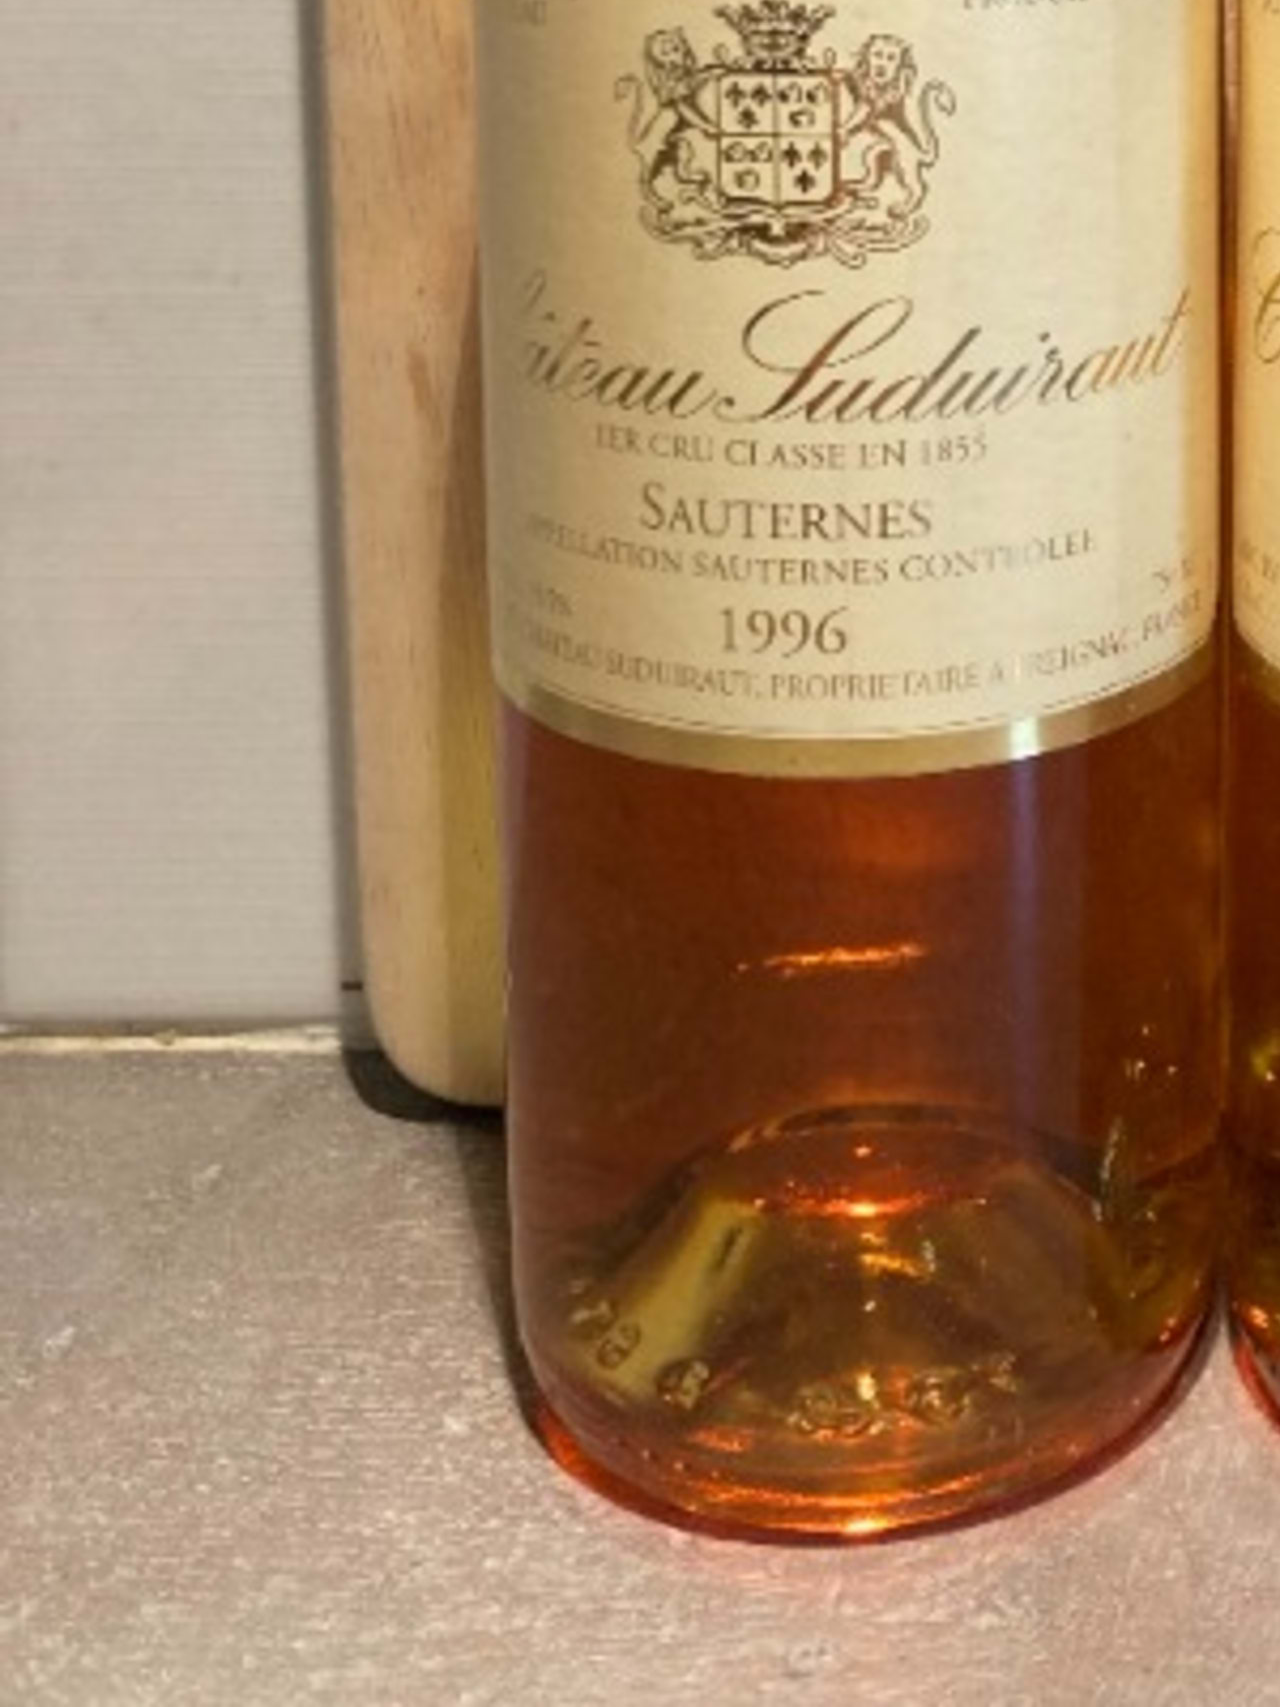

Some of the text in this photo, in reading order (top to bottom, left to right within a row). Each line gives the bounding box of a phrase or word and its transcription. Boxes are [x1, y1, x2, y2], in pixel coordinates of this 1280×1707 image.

[648, 432, 716, 463] CRU
[725, 438, 847, 470] CLASSE
[859, 436, 908, 467] EN
[640, 483, 934, 543] SAUTERNES
[692, 548, 889, 586] SAUTERNES
[718, 606, 849, 658] 1996
[770, 663, 981, 700] PROPRIETAIRE
